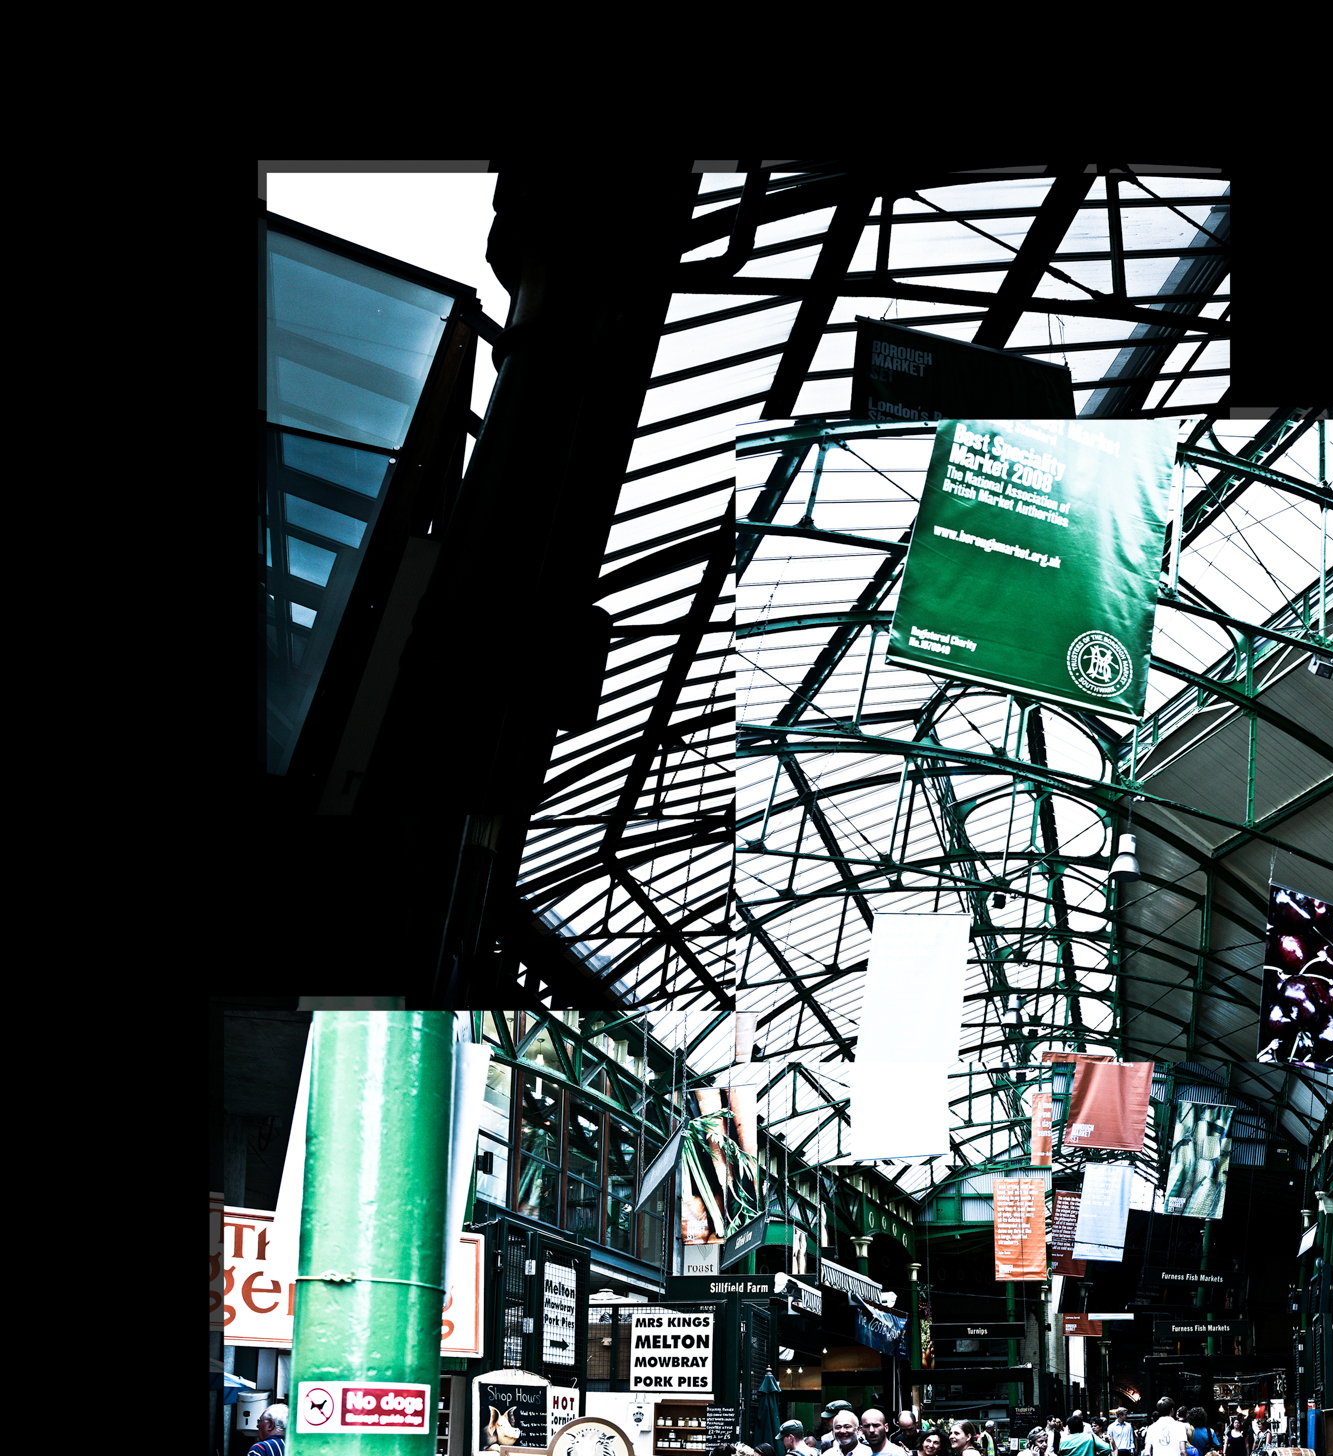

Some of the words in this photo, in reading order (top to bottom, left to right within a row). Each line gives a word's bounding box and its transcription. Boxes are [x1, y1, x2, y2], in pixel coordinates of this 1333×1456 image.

[873, 340, 932, 365] BOROUGH
[871, 353, 925, 377] MARKET
[953, 423, 990, 453] Best
[991, 435, 1066, 481] Speciality
[949, 443, 1009, 480] Market
[1011, 463, 1054, 493] 2008
[946, 465, 963, 481] The
[964, 470, 1004, 494] National
[1005, 483, 1059, 511] Association
[1059, 502, 1071, 515] of
[942, 479, 977, 500] British
[977, 489, 1015, 511] Market
[1015, 500, 1069, 527] Authorities
[933, 525, 1061, 569] www.boroughmarket.org.uk
[1070, 640, 1084, 671] TRUSTEES
[1083, 635, 1091, 645] OF
[1090, 634, 1103, 642] THE
[1103, 636, 1125, 660] BOROUGH
[1119, 659, 1129, 686] MARKET
[1078, 677, 1117, 694] SOUTHWARK
[687, 1264, 714, 1273] roast
[1161, 1272, 1184, 1281] Furness
[1186, 1273, 1198, 1281] Fish
[1200, 1274, 1223, 1283] Markets
[545, 1280, 575, 1299] Melton
[710, 1282, 744, 1293] Sillfield
[747, 1282, 769, 1293] Farm
[544, 1300, 574, 1316] Mowbray
[544, 1313, 560, 1327] Pork
[561, 1316, 575, 1329] Pies
[635, 1317, 663, 1328] MRS
[667, 1317, 710, 1328] KINGS
[635, 1335, 710, 1349] MELTON
[634, 1356, 708, 1368] MOWBRAY
[634, 1376, 673, 1387] PORK
[678, 1376, 708, 1387] PIES
[345, 1391, 376, 1410] No
[379, 1392, 423, 1413] dogs
[487, 1385, 512, 1406] Shop
[553, 1395, 575, 1411] HOT
[379, 1414, 405, 1426] guide
[405, 1414, 423, 1425] dogs
